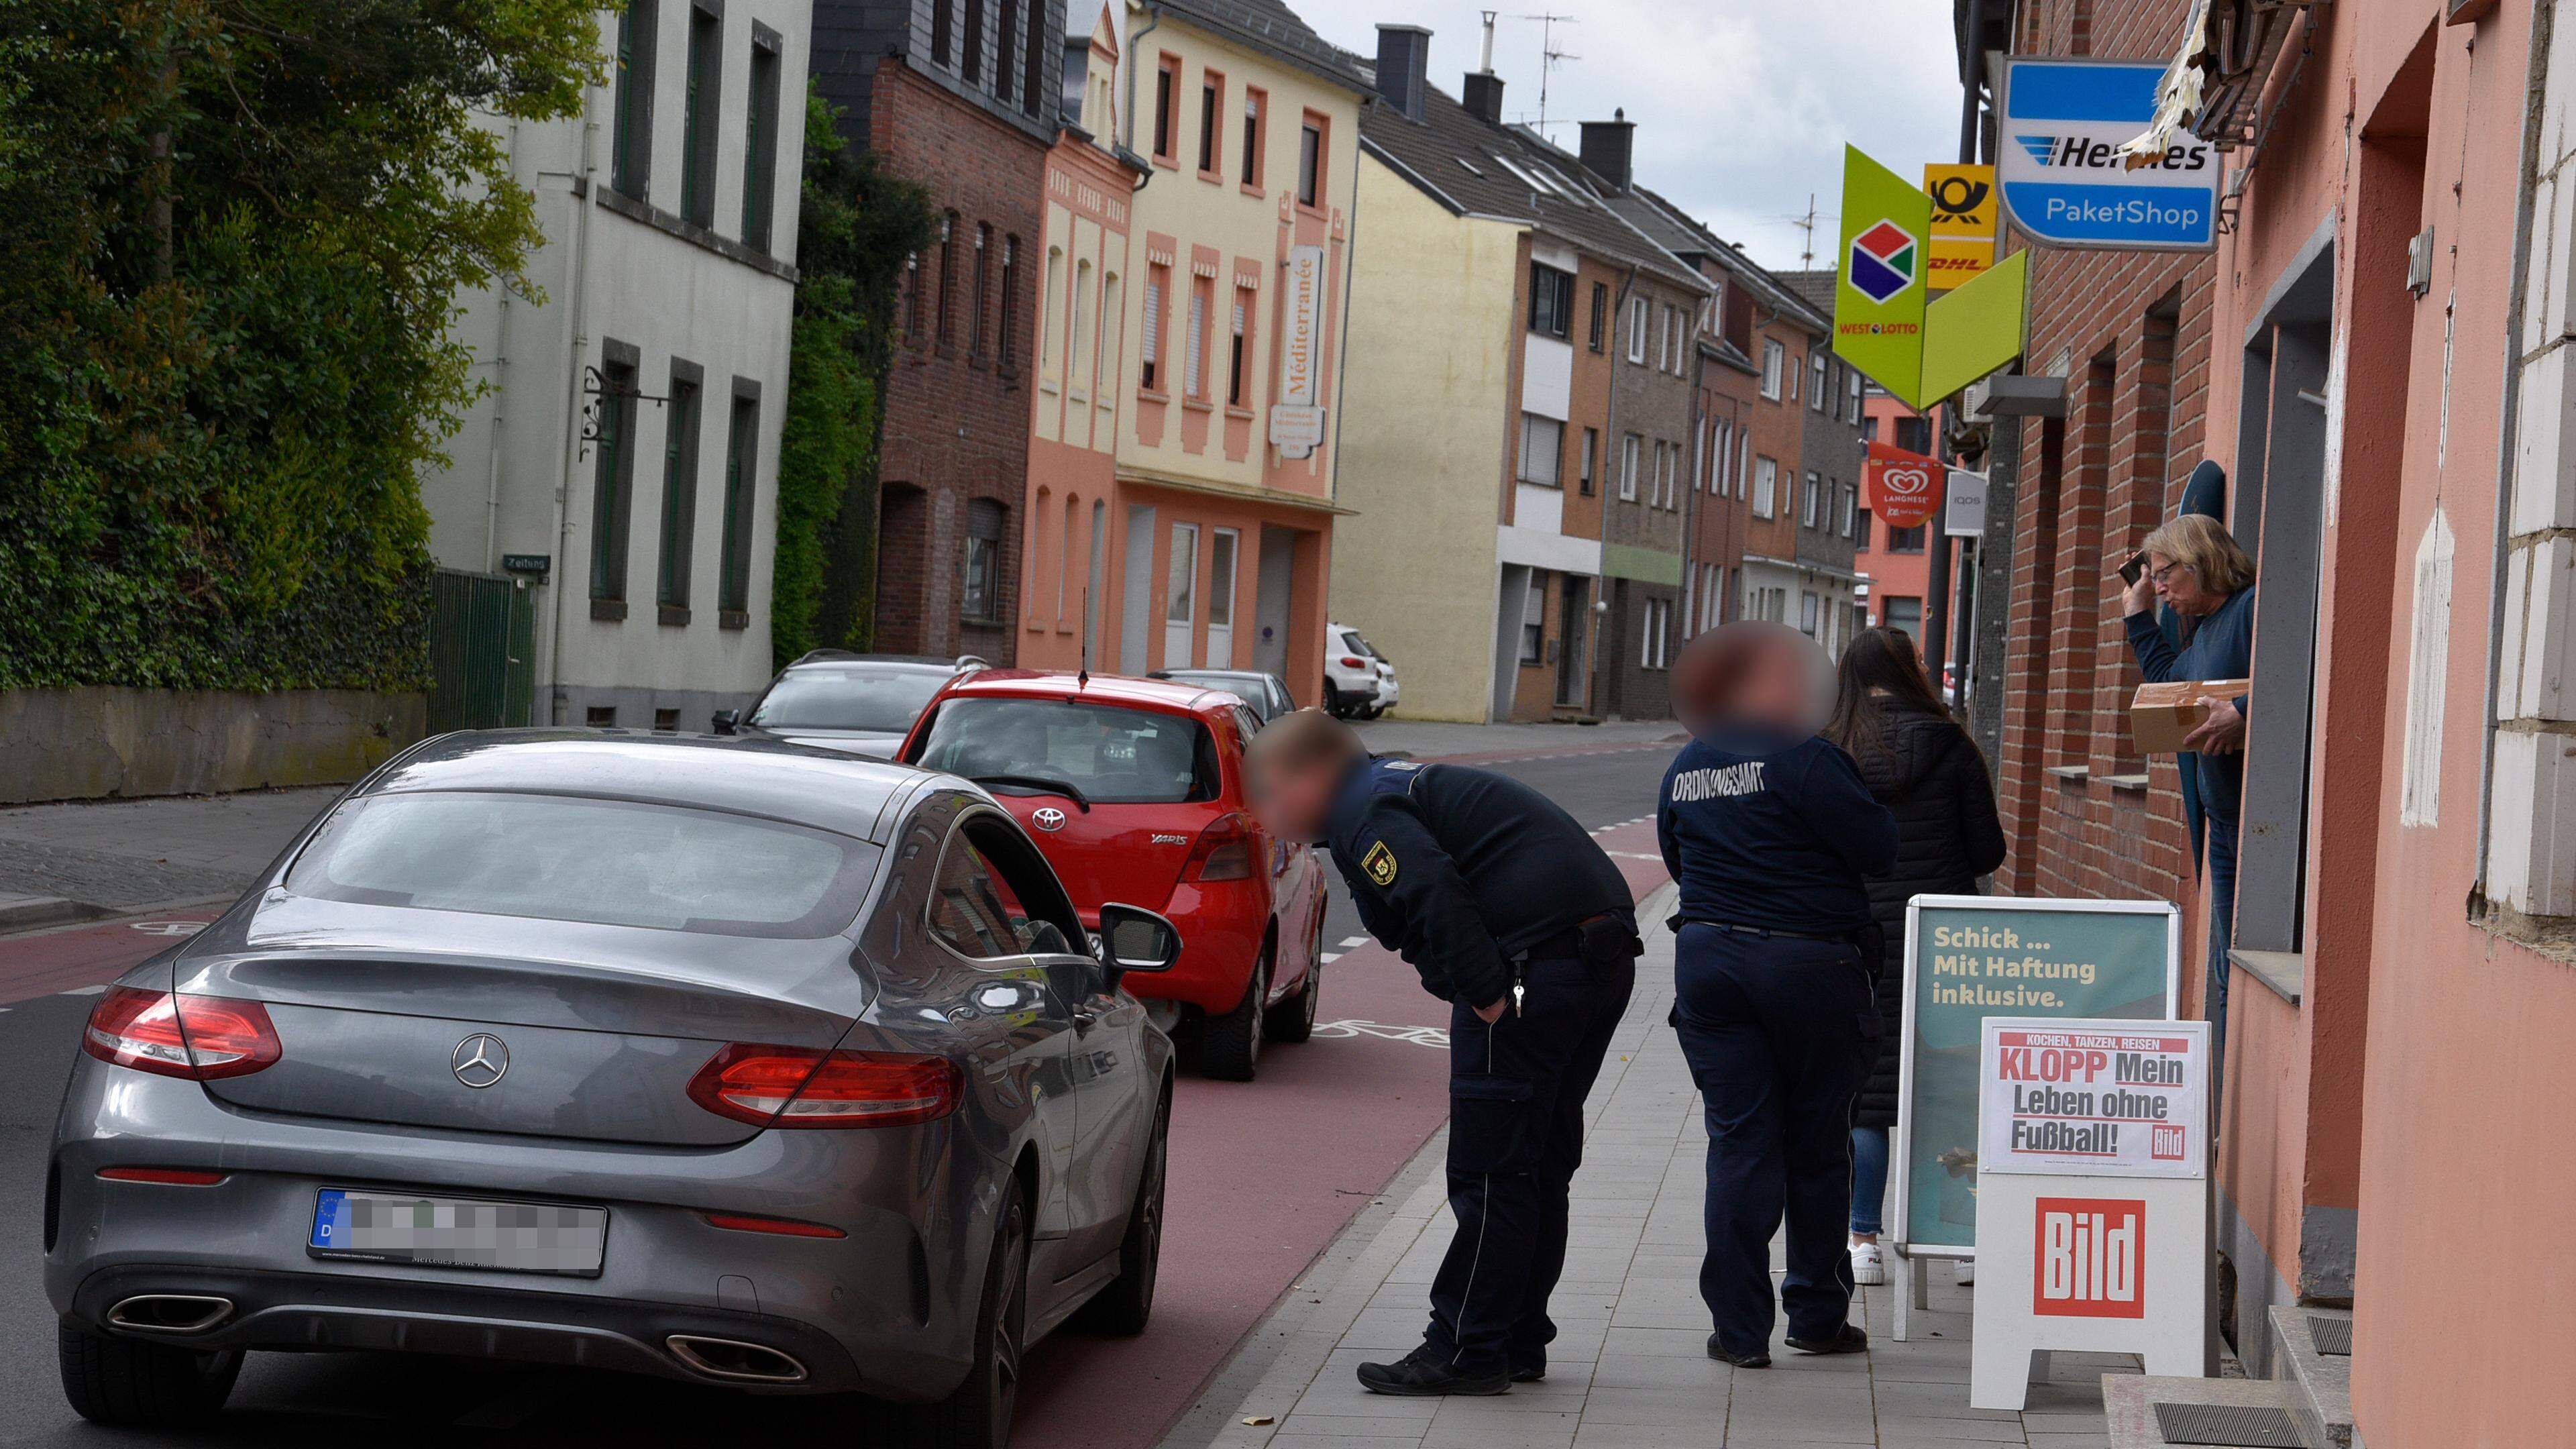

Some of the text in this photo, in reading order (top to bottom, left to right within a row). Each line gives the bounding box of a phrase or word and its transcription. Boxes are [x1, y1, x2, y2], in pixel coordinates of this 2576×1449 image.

[2047, 199, 2198, 230] PaketShop
[1929, 258, 1982, 270] DHL
[1289, 258, 1312, 395] Méditerranée
[508, 558, 545, 570] Zeitung
[1672, 761, 1765, 802] ORDNUNGSAMT
[1151, 834, 1187, 845] YARIS
[1934, 926, 2019, 949] Schick
[1933, 954, 2096, 984] Mit Haftung
[1933, 981, 2063, 1008] inklusive.
[2026, 1034, 2159, 1051] KOCHEN, TANZEN, REISEN
[1999, 1048, 2183, 1083] KLOPP Mein
[2014, 1085, 2167, 1119] Leben ohne
[2011, 1120, 2118, 1152] Fußball!
[2154, 1128, 2183, 1155] Bild
[321, 1224, 331, 1237] D
[2043, 1212, 2136, 1301] Bild
